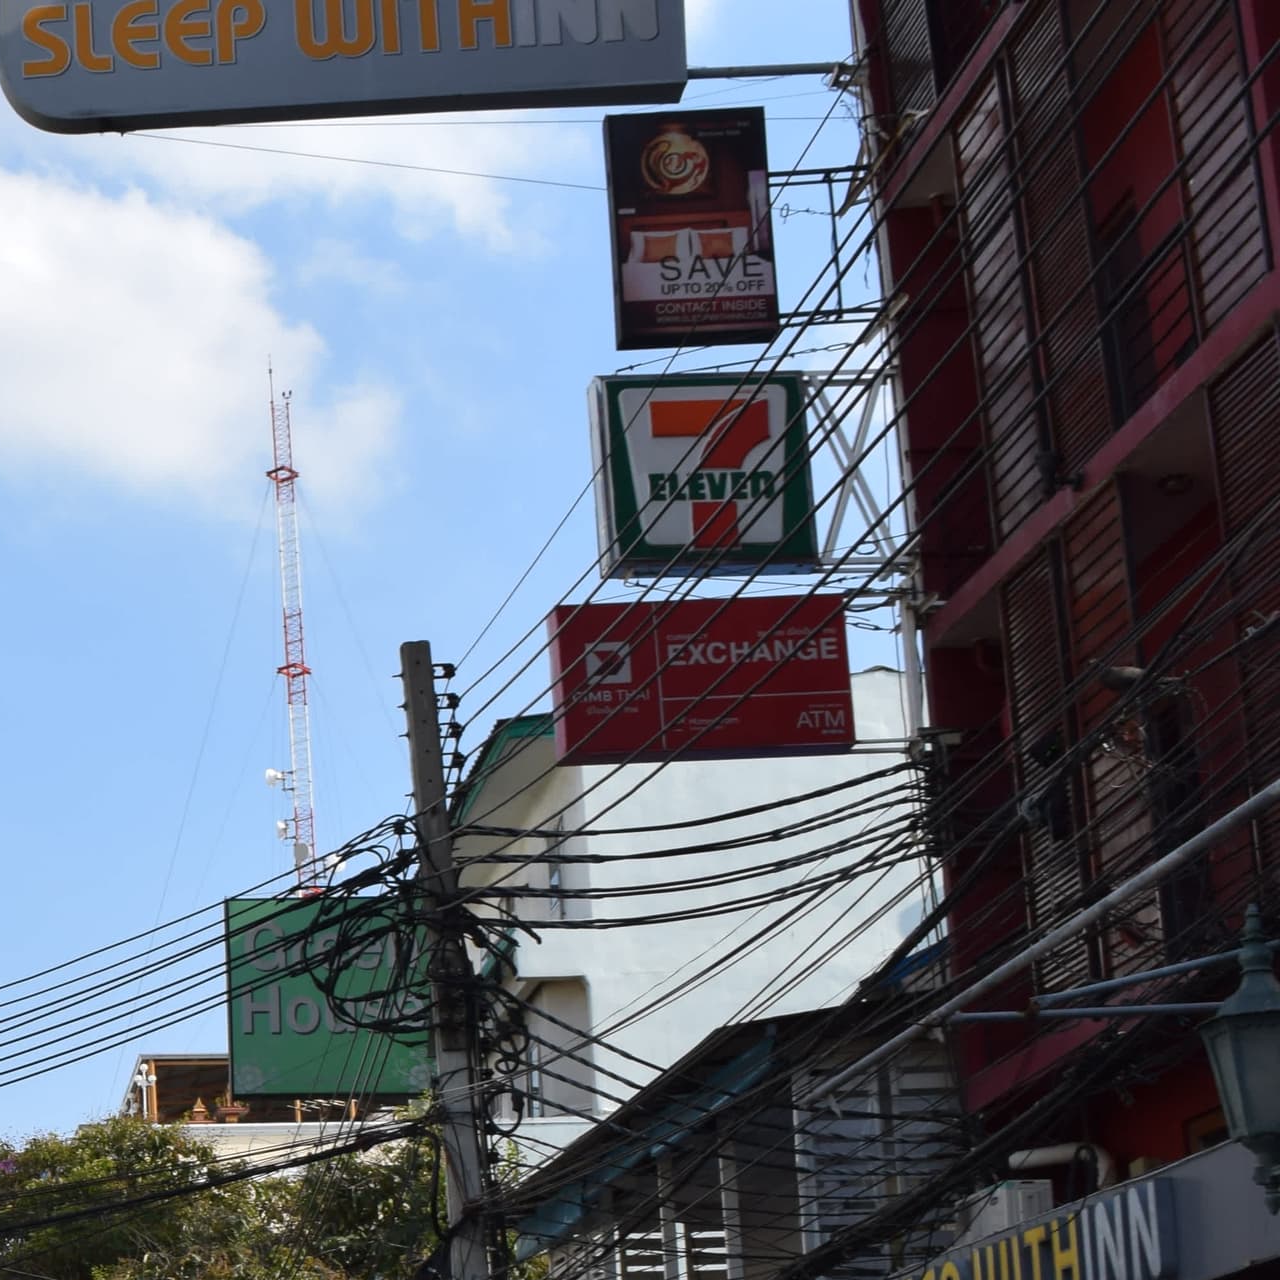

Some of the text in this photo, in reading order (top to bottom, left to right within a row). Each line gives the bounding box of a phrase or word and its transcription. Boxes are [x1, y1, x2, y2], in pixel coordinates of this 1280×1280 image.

[22, 0, 265, 79] SLEEP
[660, 254, 764, 281] SAVE
[661, 284, 680, 295] UP
[683, 283, 701, 294] TO
[736, 280, 766, 292] OFF
[655, 299, 767, 314] CONTACT INSIDE
[667, 637, 840, 667] EXCHANGE
[572, 689, 651, 703] CIMB THAI
[796, 710, 846, 730] ATM
